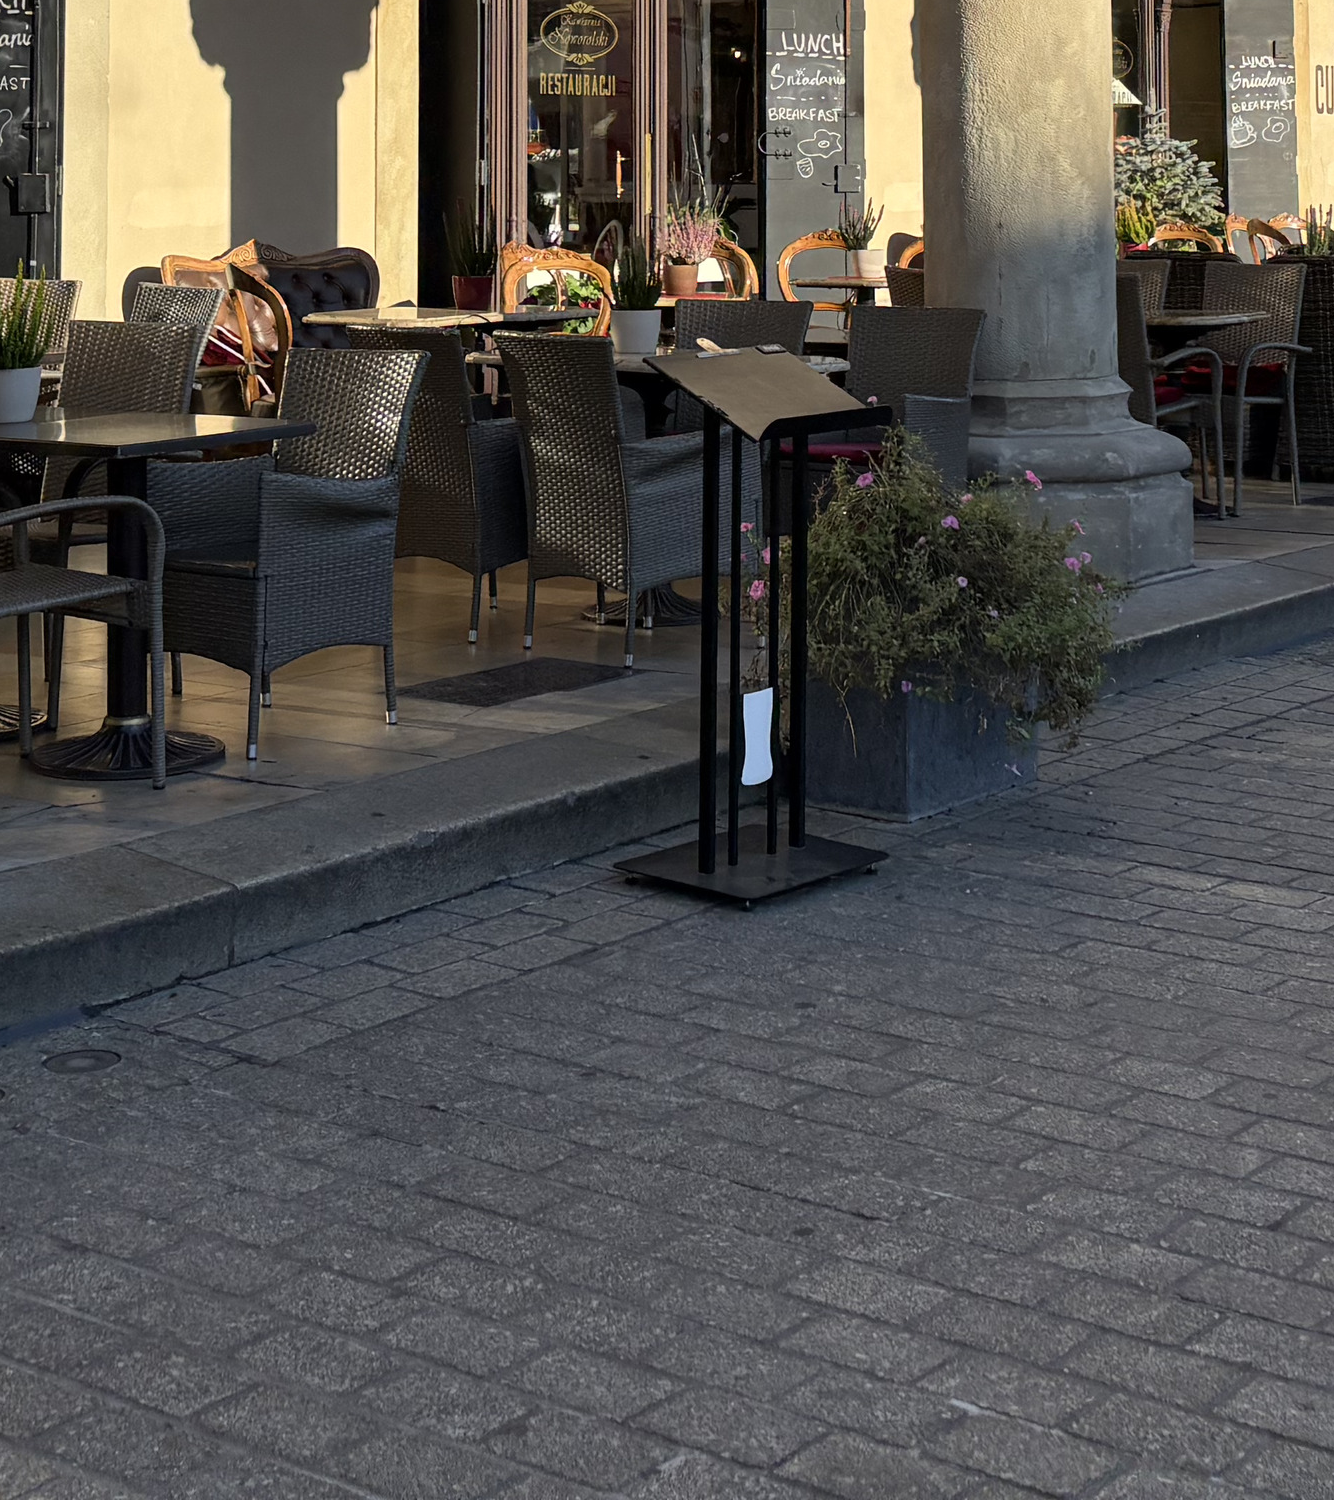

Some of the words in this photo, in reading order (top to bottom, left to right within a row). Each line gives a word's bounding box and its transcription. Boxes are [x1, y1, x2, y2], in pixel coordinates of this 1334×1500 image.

[548, 27, 609, 47] Noworolski
[781, 31, 844, 55] LUNCH
[539, 72, 616, 96] RESTAURACJI
[768, 108, 842, 122] BREAKFAST
[1231, 99, 1296, 114] BREAKFAST
